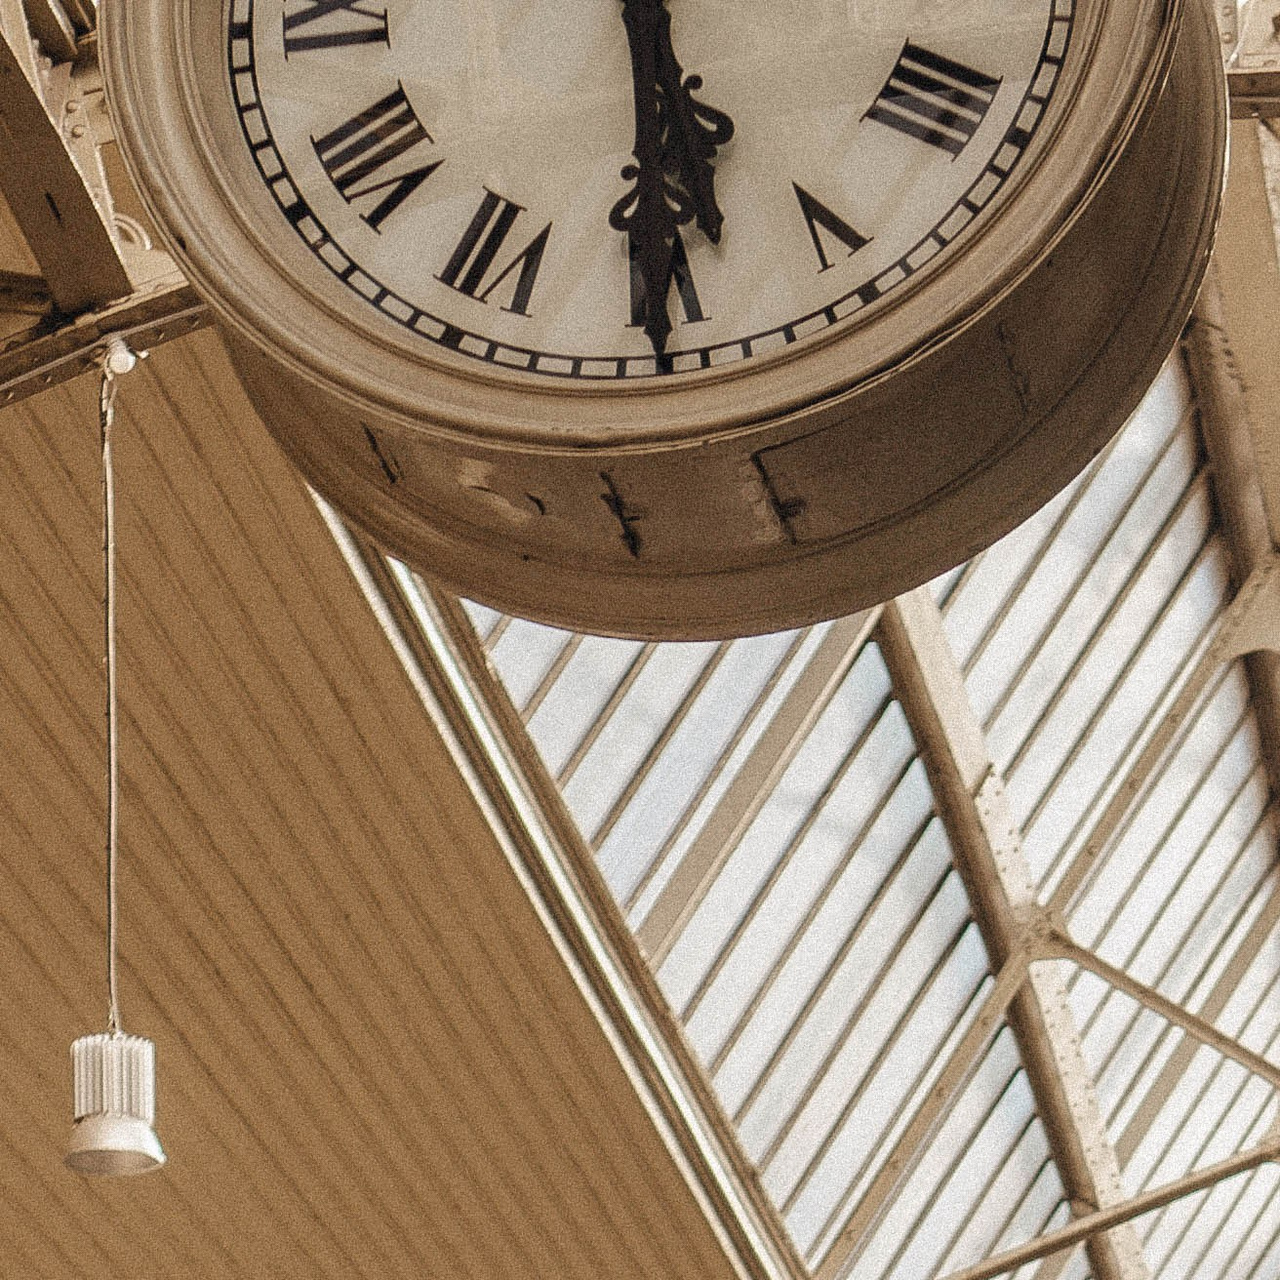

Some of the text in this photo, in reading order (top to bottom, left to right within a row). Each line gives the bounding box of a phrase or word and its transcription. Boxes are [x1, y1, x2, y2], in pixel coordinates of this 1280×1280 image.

[309, 78, 446, 235] VIII
[859, 36, 1004, 163] IIII
[433, 185, 553, 318] VII
[791, 179, 875, 275] V
